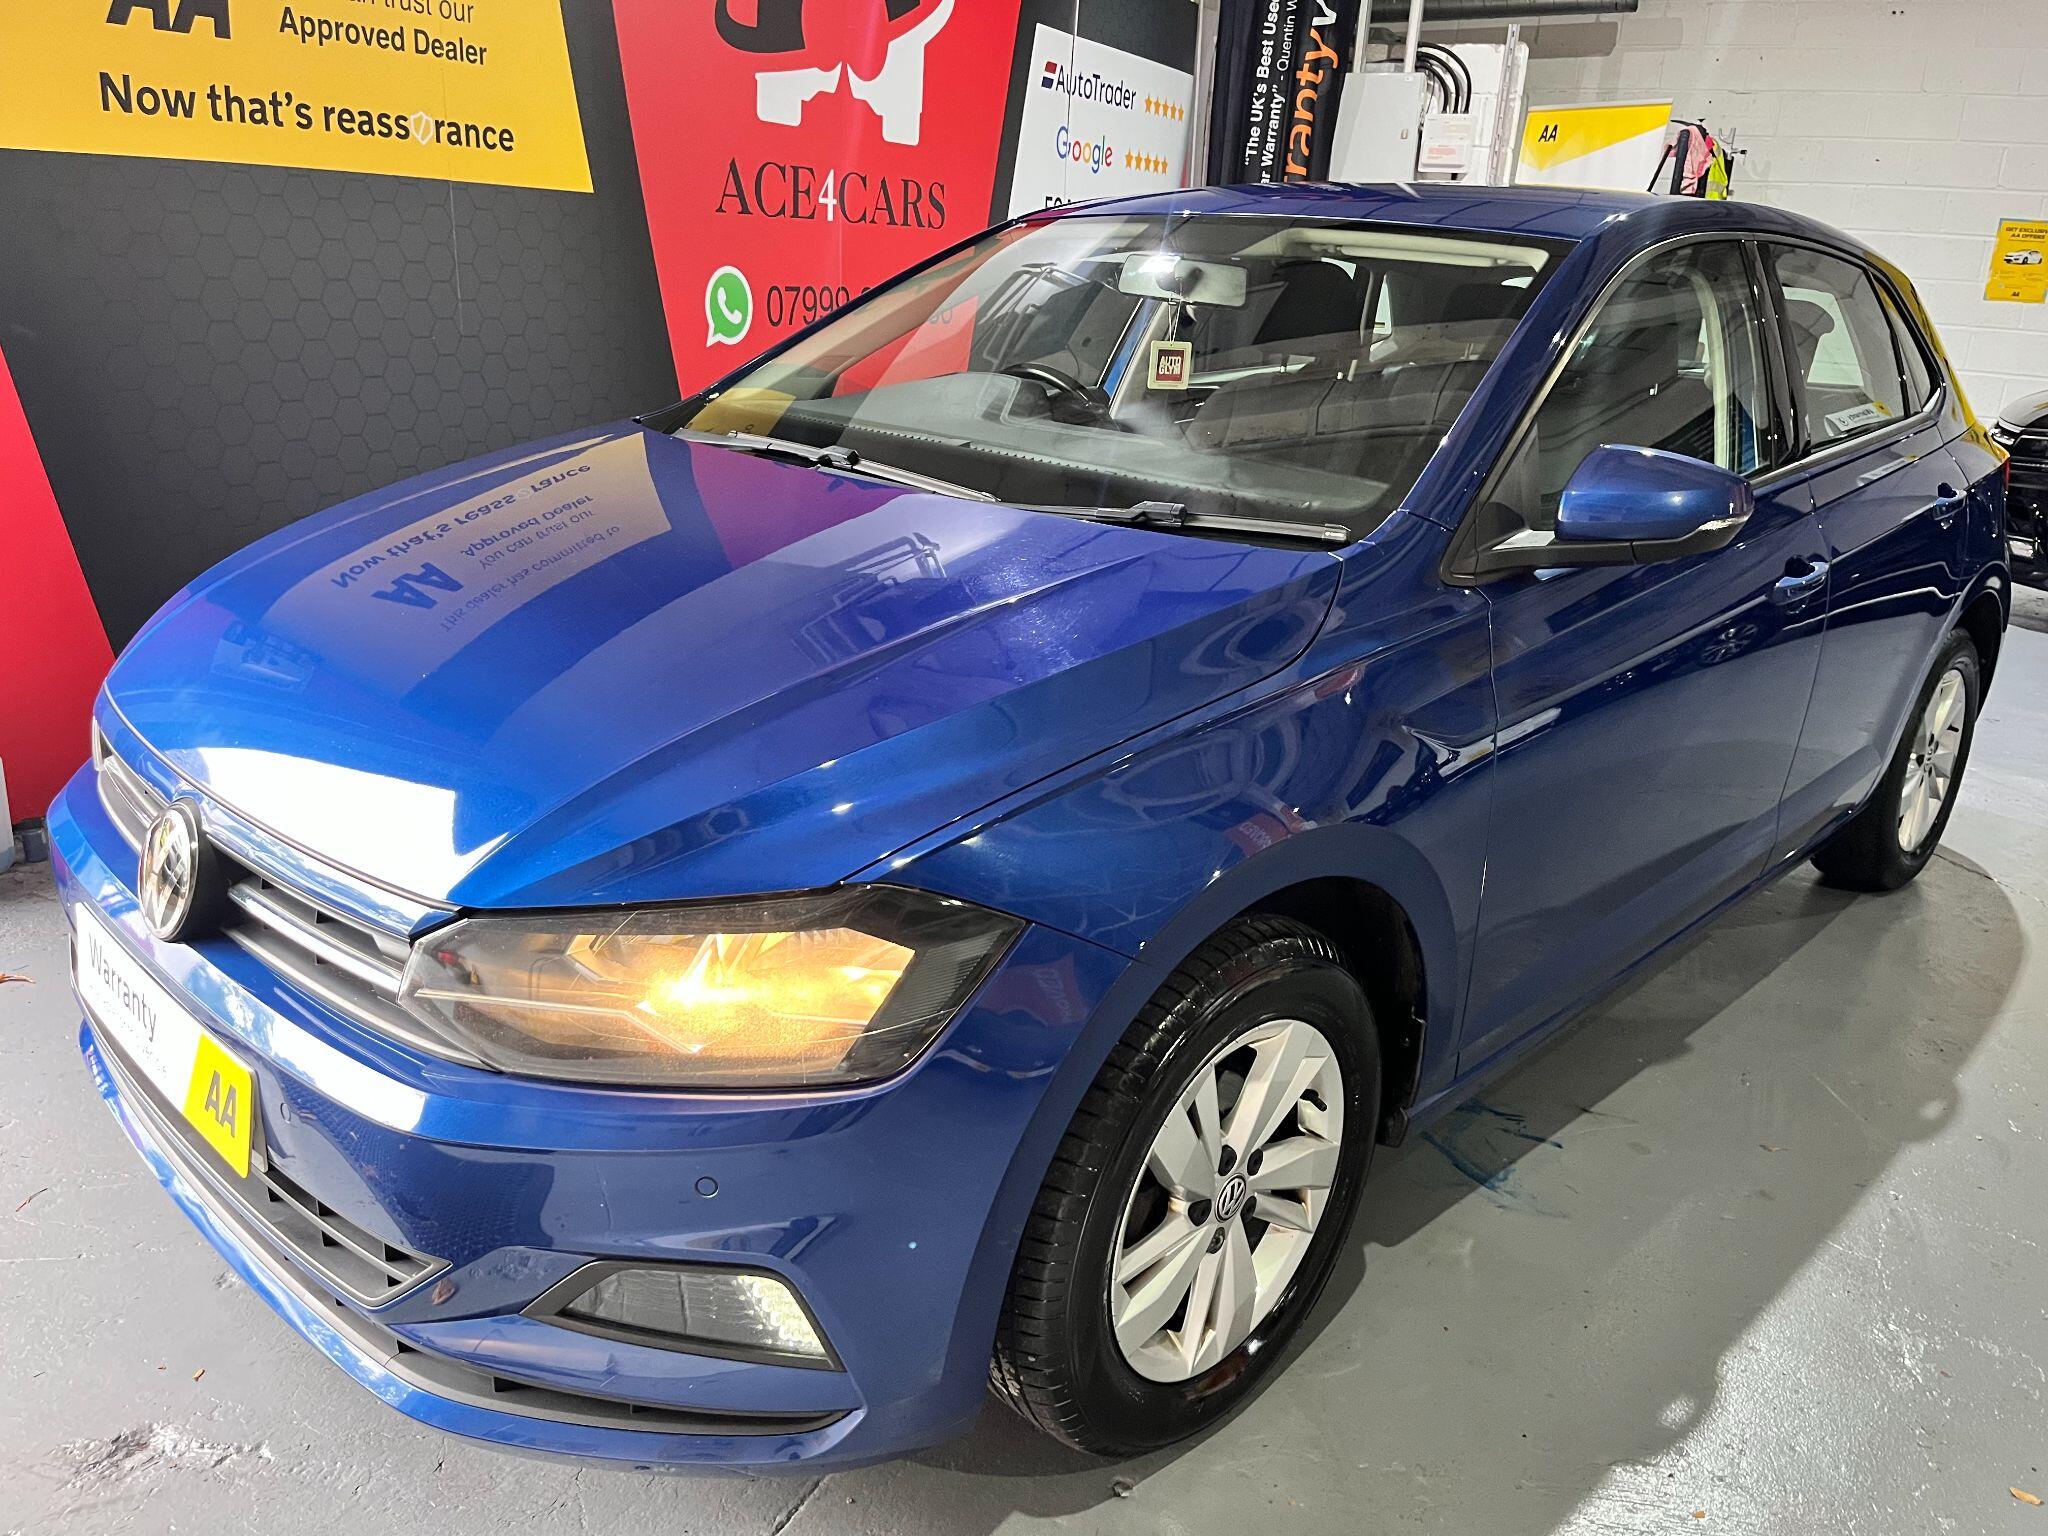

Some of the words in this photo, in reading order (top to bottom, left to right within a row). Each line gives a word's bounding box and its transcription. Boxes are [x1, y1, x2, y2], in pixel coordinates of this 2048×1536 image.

[279, 6, 405, 52] Approved
[413, 28, 488, 66] Dealer
[439, 0, 474, 23] our
[1263, 0, 1280, 35] Use
[1256, 39, 1274, 79] Best
[1277, 15, 1296, 71] Quentin
[99, 71, 197, 120] Now
[1055, 65, 1137, 111] AutoTrader
[1056, 125, 1113, 174] Google
[1538, 124, 1559, 143] AA
[715, 157, 946, 230] ACE4CARS
[1160, 356, 1182, 367] AUTO
[87, 931, 158, 1043] Warranty
[204, 1069, 238, 1139] AA
